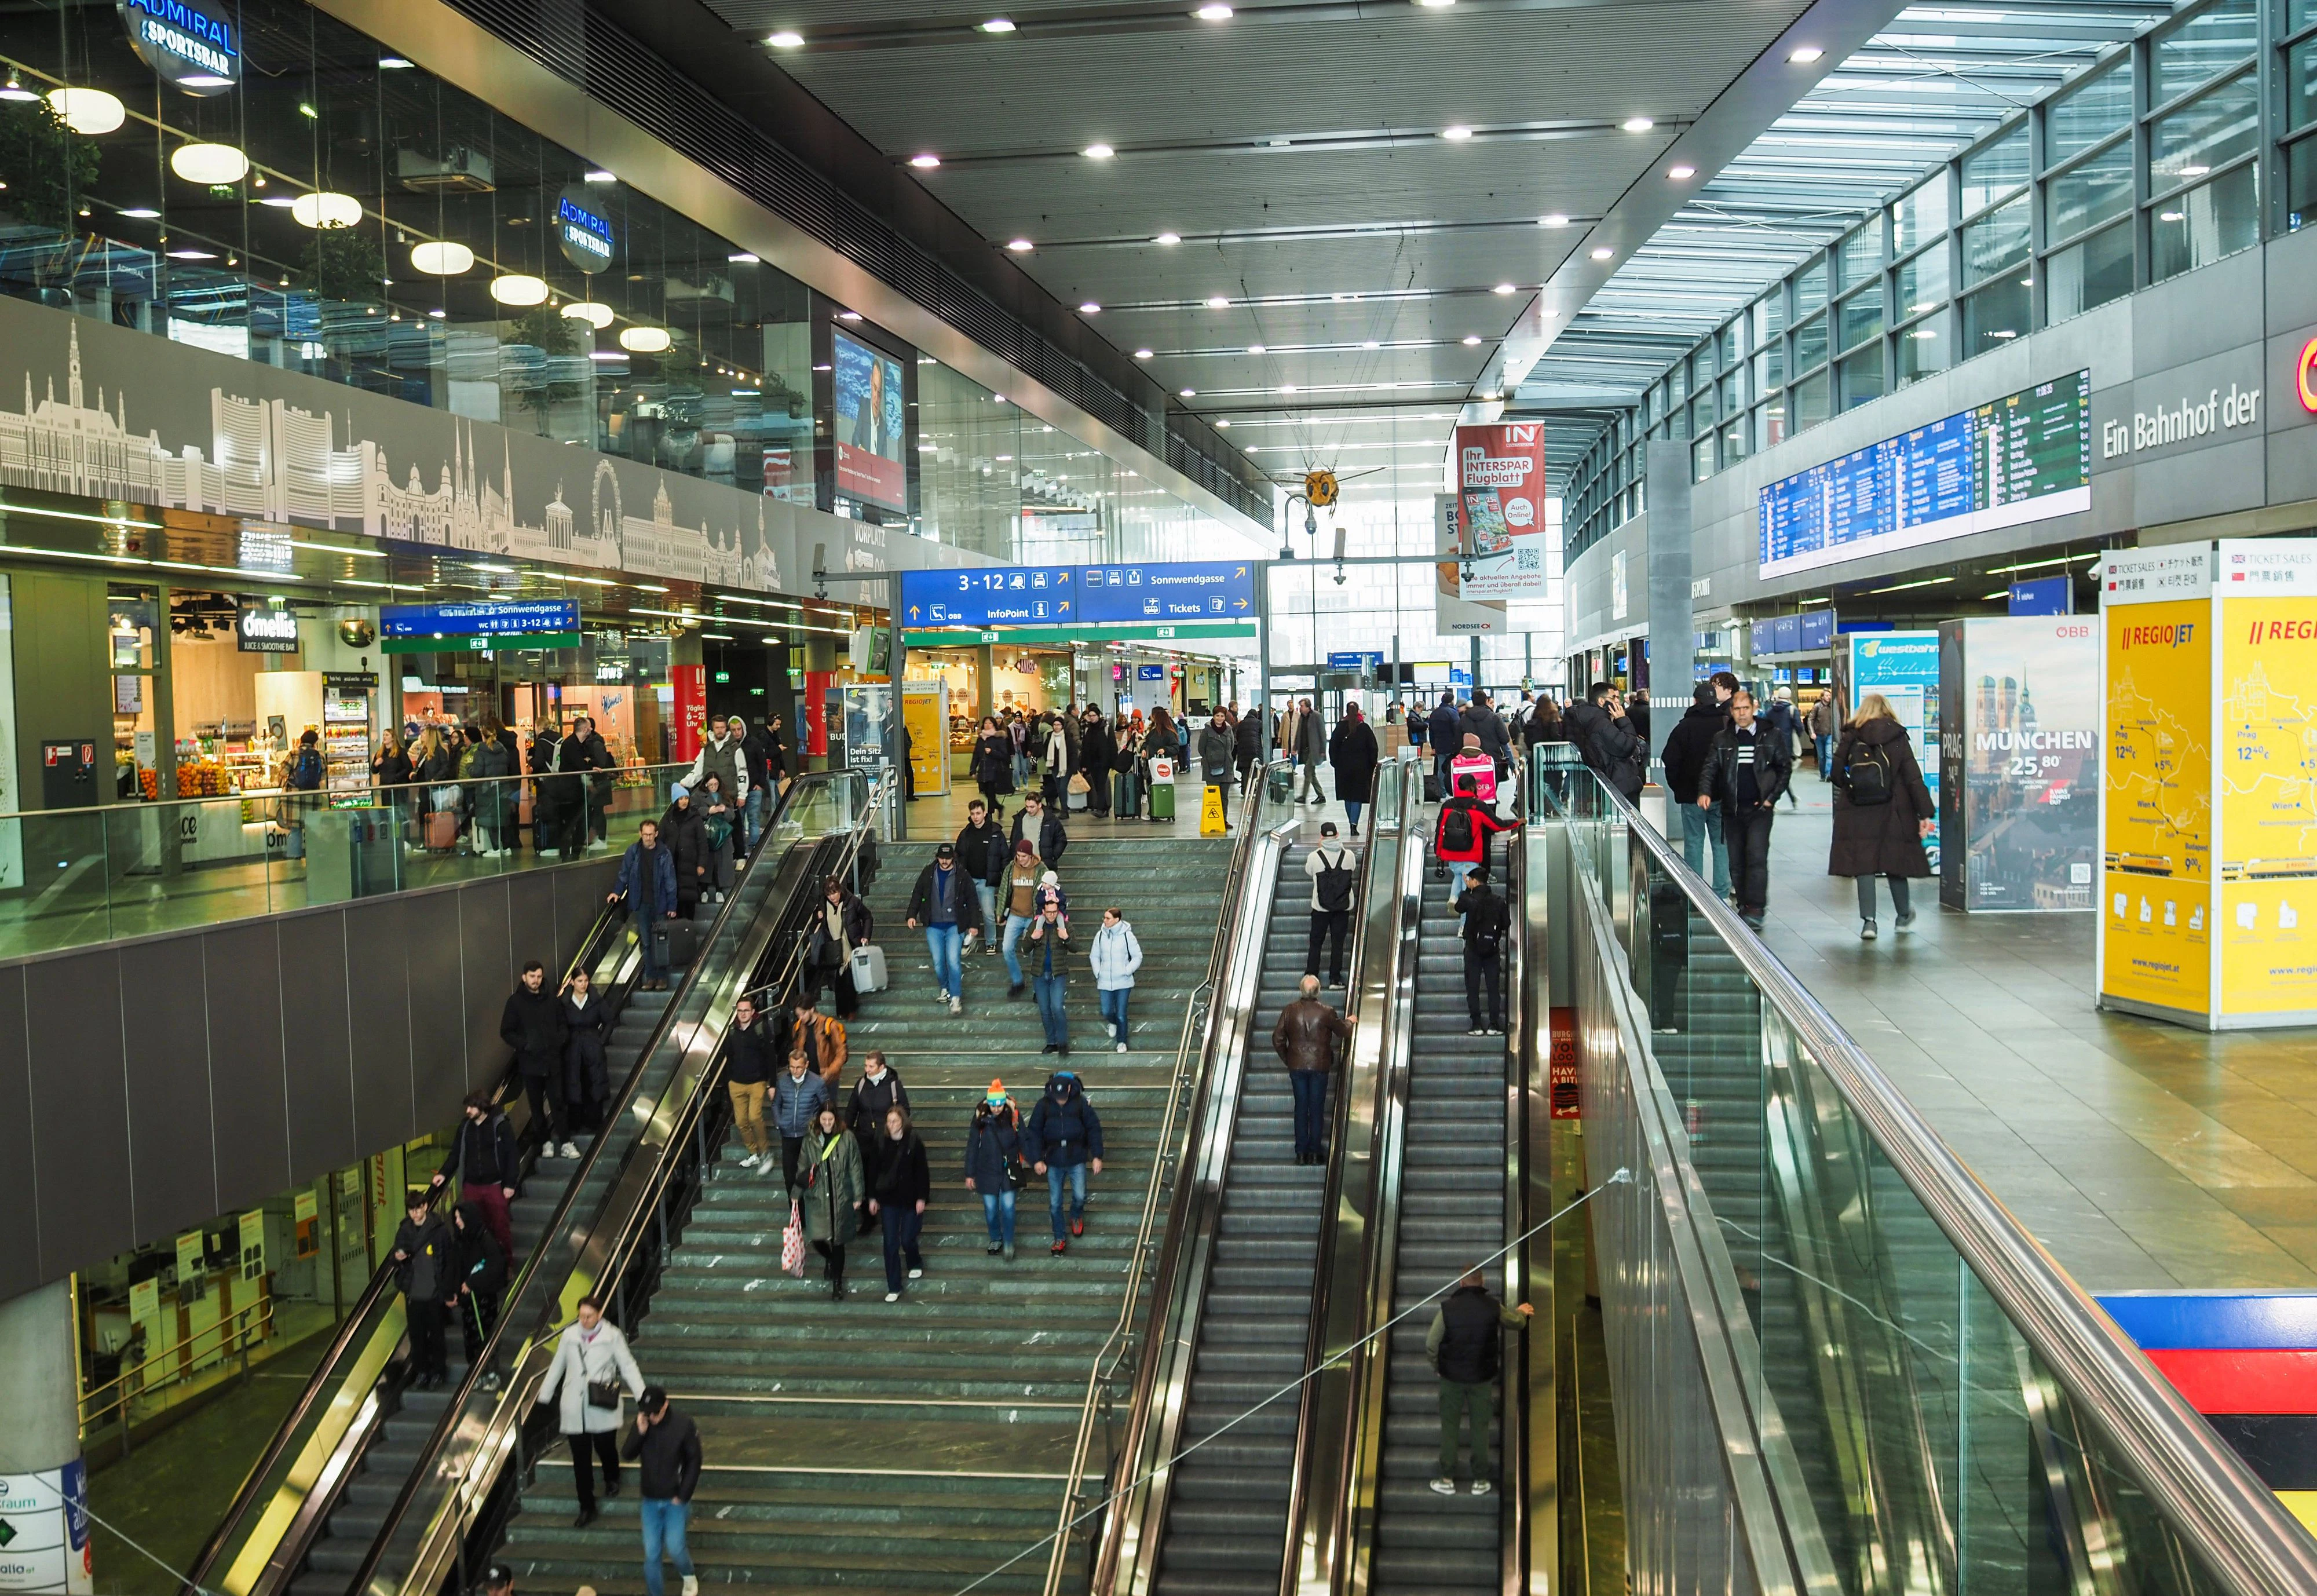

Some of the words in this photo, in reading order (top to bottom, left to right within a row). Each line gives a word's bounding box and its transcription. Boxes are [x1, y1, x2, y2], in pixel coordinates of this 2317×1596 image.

[148, 21, 229, 75] SPORTSBAR
[561, 198, 613, 243] ADMIRAL
[569, 225, 610, 257] SPORTSBAR
[2103, 418, 2129, 459] Ein
[2135, 389, 2219, 451] Bahnhof
[2223, 382, 2260, 428] der
[1505, 426, 1534, 443] IN
[1466, 450, 1482, 461] Ihr
[1467, 461, 1529, 472] INTERSPAR
[1467, 472, 1520, 485] Flugblatt
[854, 523, 886, 547] VORPLATZ
[2249, 554, 2280, 564] TICKET
[2283, 553, 2312, 563] SALES
[2118, 564, 2136, 574] TICKET
[2137, 562, 2155, 572] SALES
[1151, 575, 1225, 586] Sonnwendgasse
[498, 604, 562, 615] Sonnwendgasse
[1168, 603, 1201, 613] Tickets
[987, 609, 1029, 619] InfoPoint
[2133, 624, 2194, 648] REGIOJET
[244, 641, 257, 650] JUICE
[261, 642, 286, 651] SMOOTHIE
[286, 642, 295, 651] BAR
[1878, 644, 1939, 654] westbahn
[1020, 658, 1034, 674] ANKER
[1976, 727, 2092, 751] MÜNCHEN
[2115, 731, 2128, 740] Prag
[2236, 731, 2257, 740] Prag
[1943, 733, 1962, 759] PRAG
[2137, 800, 2151, 808] Wien
[2185, 842, 2209, 852] Budapest
[2132, 957, 2180, 973] www.regiojet.at
[1552, 1030, 1572, 1038] BURG
